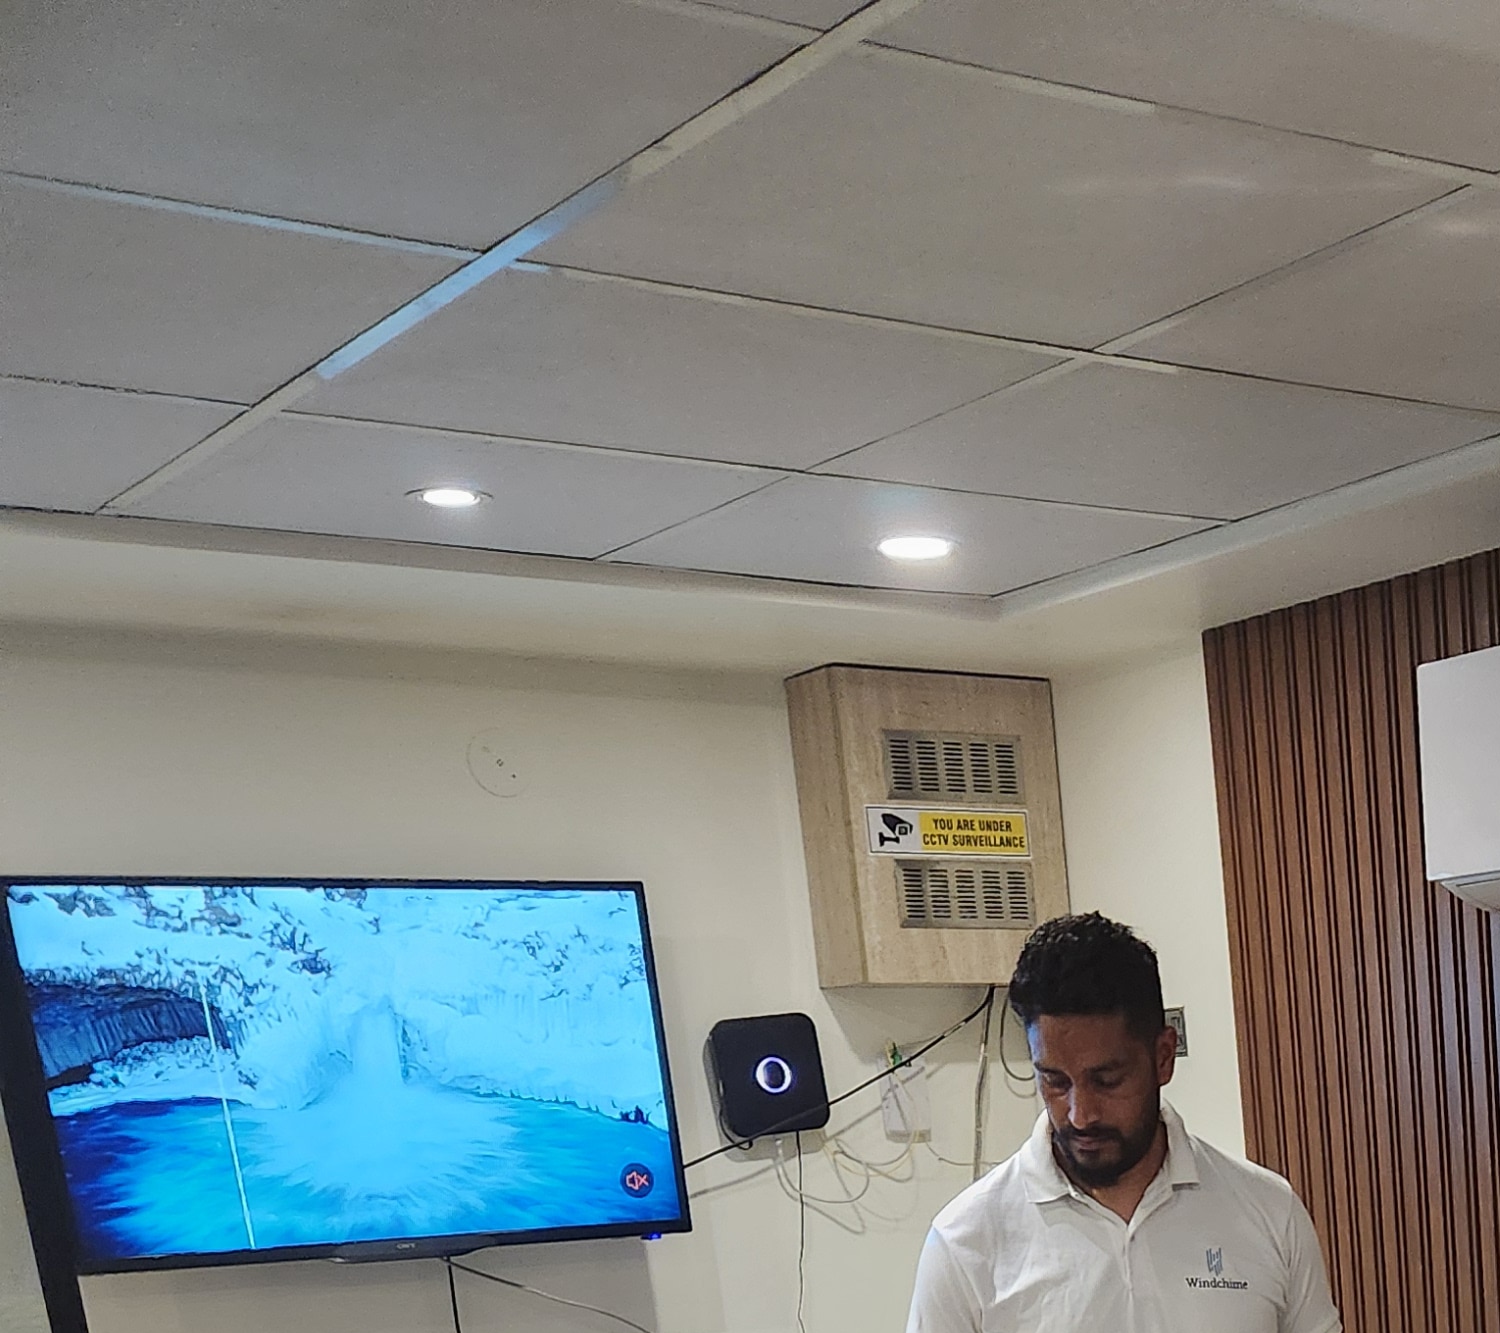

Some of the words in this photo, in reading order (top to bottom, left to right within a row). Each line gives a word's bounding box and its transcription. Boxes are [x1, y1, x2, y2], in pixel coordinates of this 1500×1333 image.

[933, 818, 953, 830] YOU
[957, 820, 975, 831] ARE
[979, 820, 1012, 832] UNDER
[923, 834, 949, 845] CCTV
[953, 835, 1025, 848] SURVEILLANCE
[1186, 1278, 1248, 1289] Windchime
